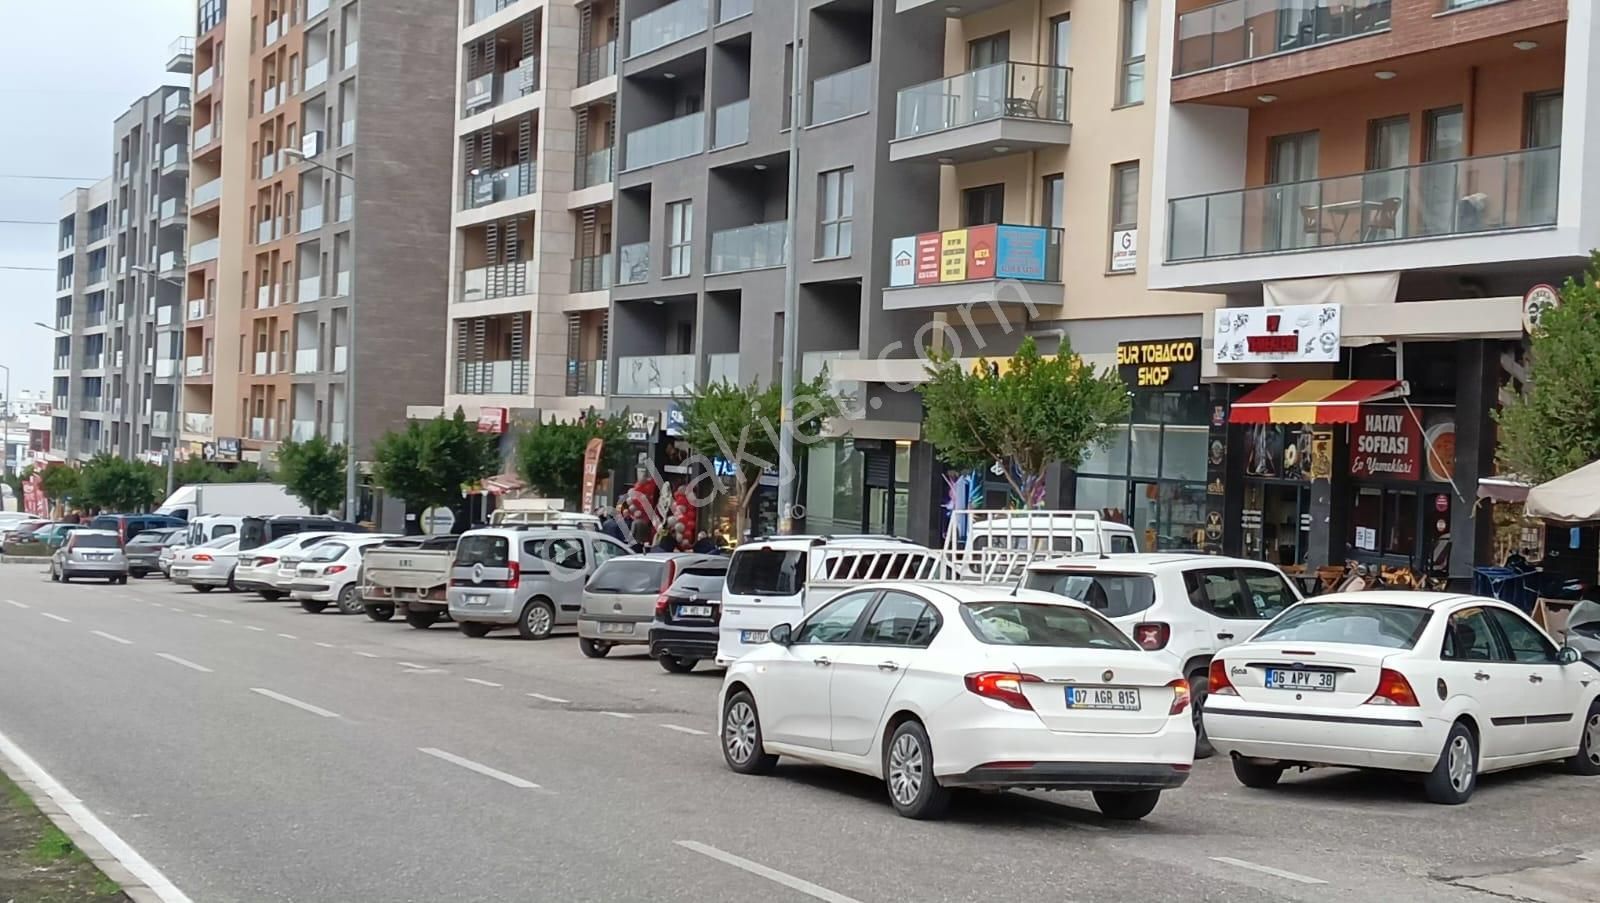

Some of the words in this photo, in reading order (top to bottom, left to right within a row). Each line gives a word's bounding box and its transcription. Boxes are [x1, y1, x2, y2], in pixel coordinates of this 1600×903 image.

[1141, 342, 1194, 363] TOBACCO
[1138, 366, 1170, 386] SHOP
[1365, 414, 1403, 433] HATAY
[1358, 435, 1409, 454] SOFRASI
[1272, 671, 1285, 684] 06
[1291, 672, 1311, 685] APV
[1318, 673, 1333, 687] 38
[1074, 690, 1087, 704] 07
[1094, 690, 1113, 704] AGR
[1118, 690, 1136, 705] 815
